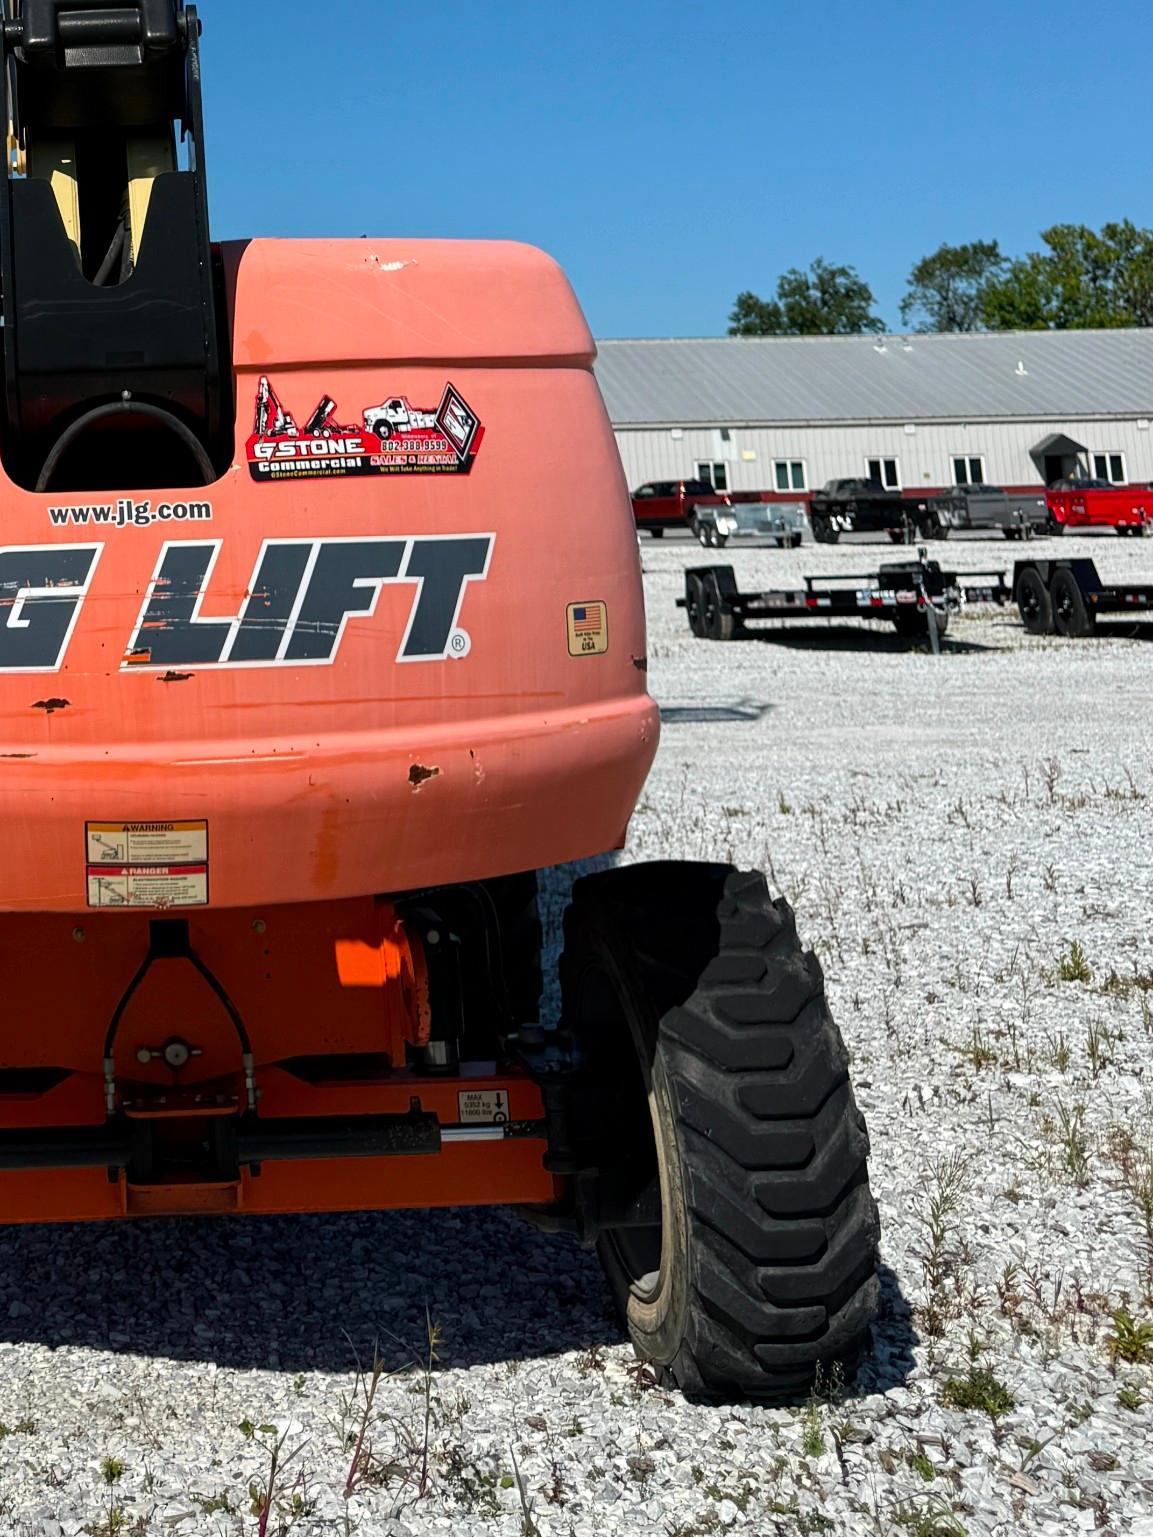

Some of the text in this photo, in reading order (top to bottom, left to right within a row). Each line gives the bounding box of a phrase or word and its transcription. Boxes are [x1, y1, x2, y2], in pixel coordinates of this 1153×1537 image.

[381, 439, 448, 452] 802.388.9599
[258, 457, 362, 472] Commercial
[370, 455, 407, 466] SALES
[271, 469, 346, 479] GStoneCommercial.com
[49, 500, 212, 526] www.jlg.com
[582, 642, 595, 651] USA
[130, 824, 174, 832] WARNING
[129, 867, 169, 875] DANGER
